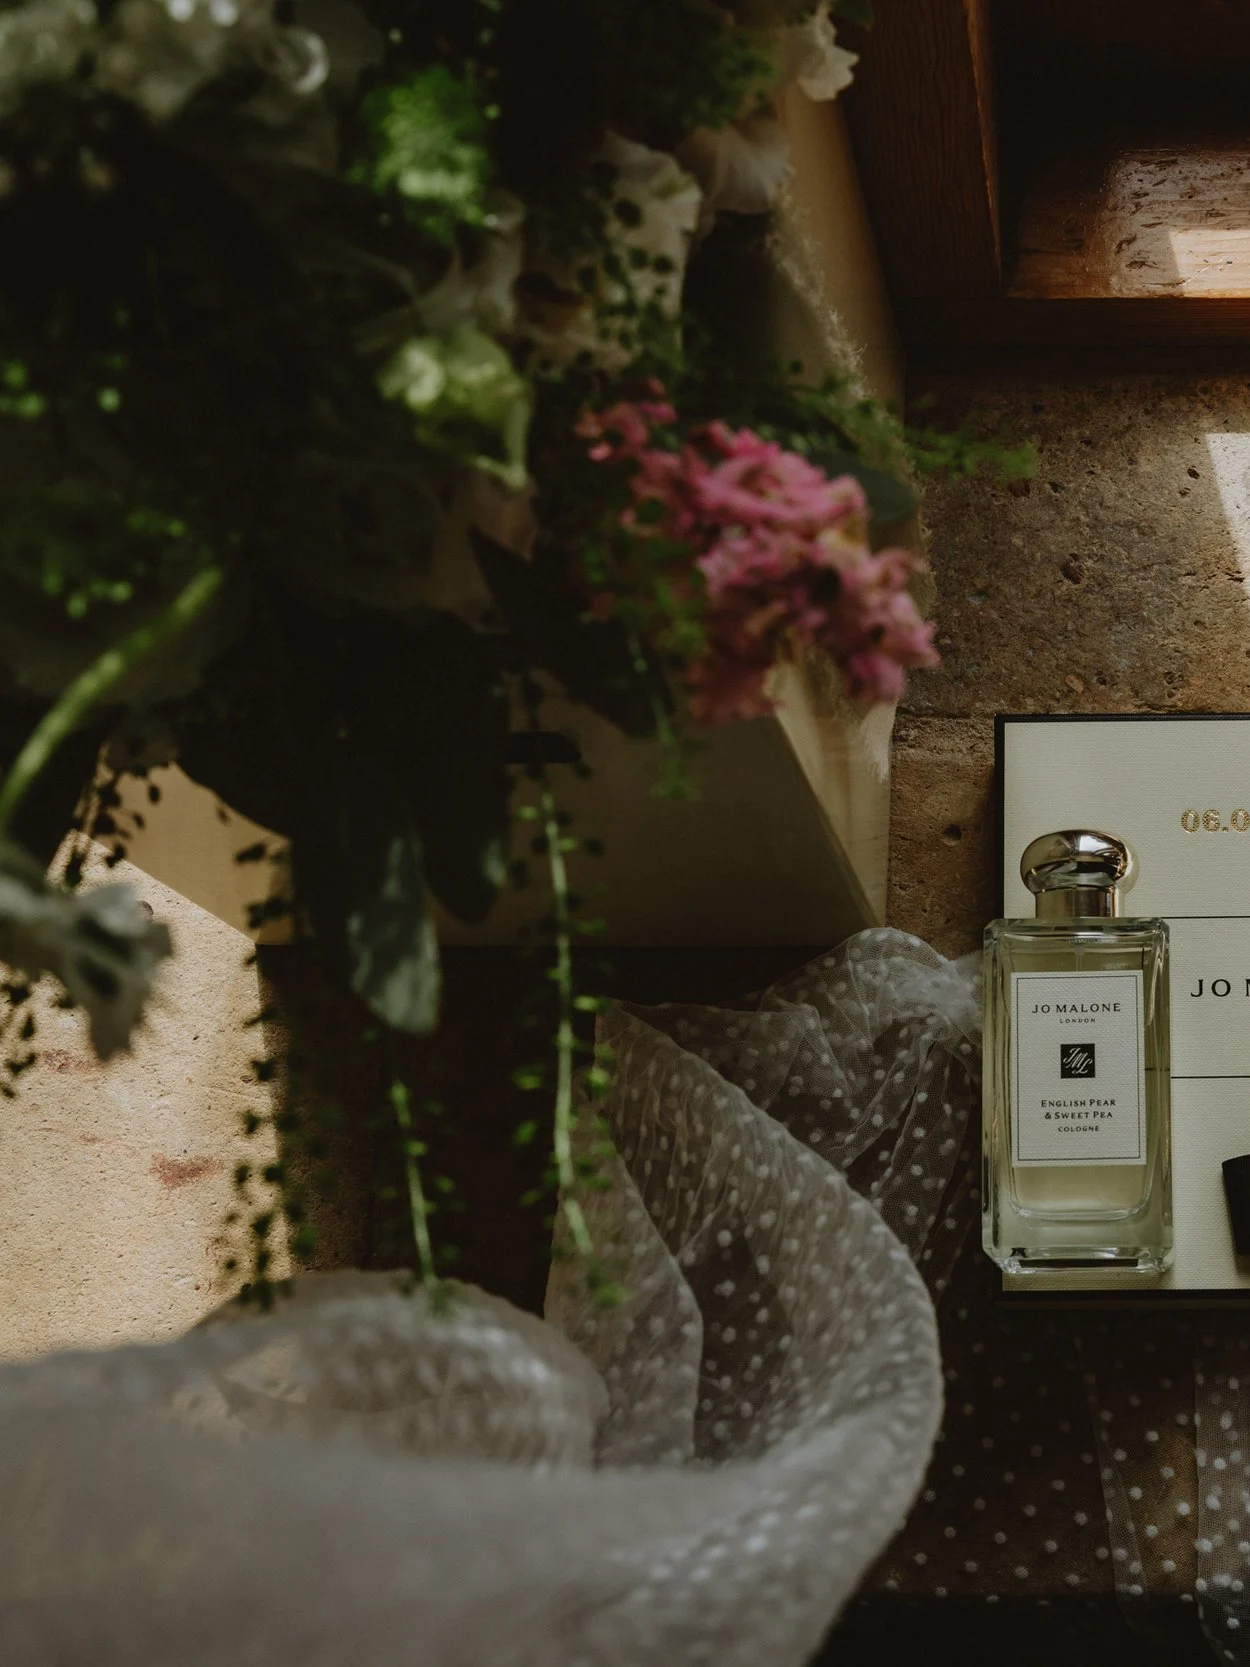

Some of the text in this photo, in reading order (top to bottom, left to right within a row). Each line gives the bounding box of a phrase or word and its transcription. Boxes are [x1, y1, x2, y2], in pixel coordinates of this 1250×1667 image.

[1190, 978, 1232, 998] JO
[1032, 1003, 1121, 1014] JO MALONE
[1044, 1111, 1052, 1120] &
[1058, 1125, 1100, 1133] COLOGNE
